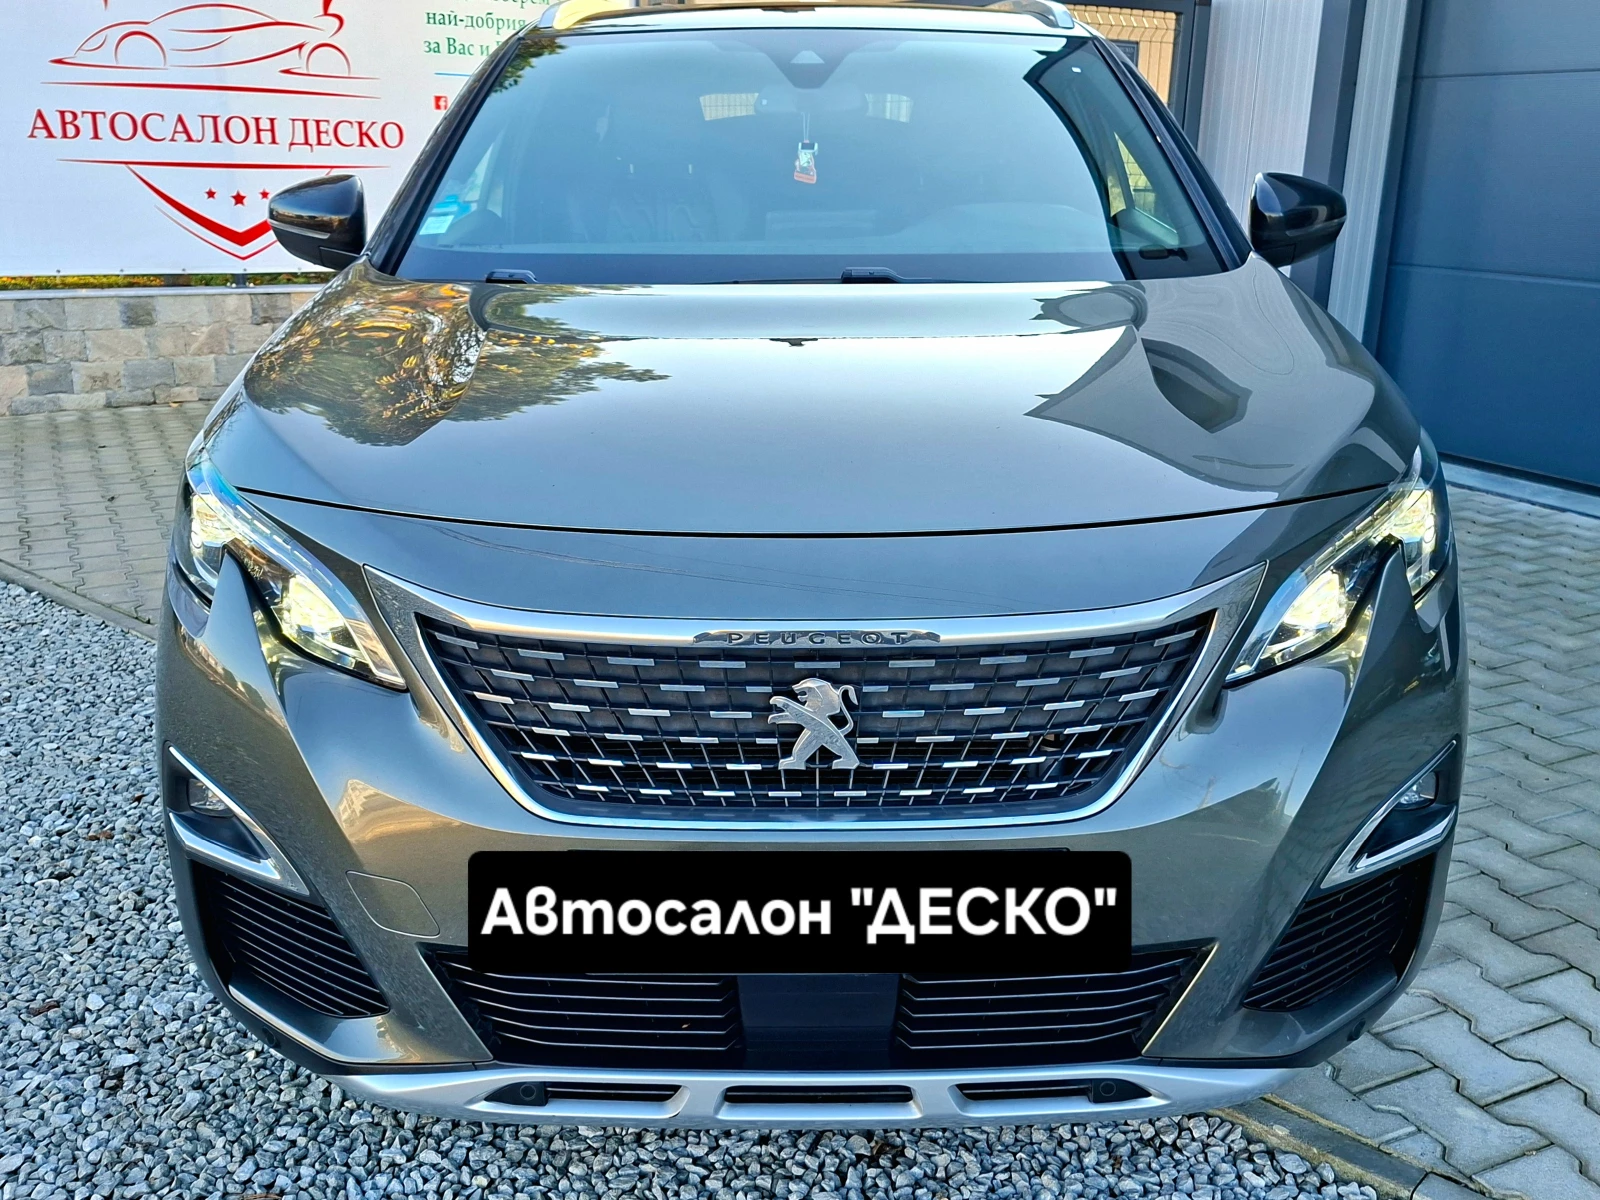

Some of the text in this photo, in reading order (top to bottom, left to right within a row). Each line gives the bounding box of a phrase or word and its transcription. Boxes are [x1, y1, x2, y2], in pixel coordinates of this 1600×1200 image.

[425, 10, 526, 35] най-добрия
[423, 37, 490, 56] за Вас и
[27, 108, 404, 152] АВТОСАЛОН ДЕСКО
[726, 631, 909, 645] PEUGEOT
